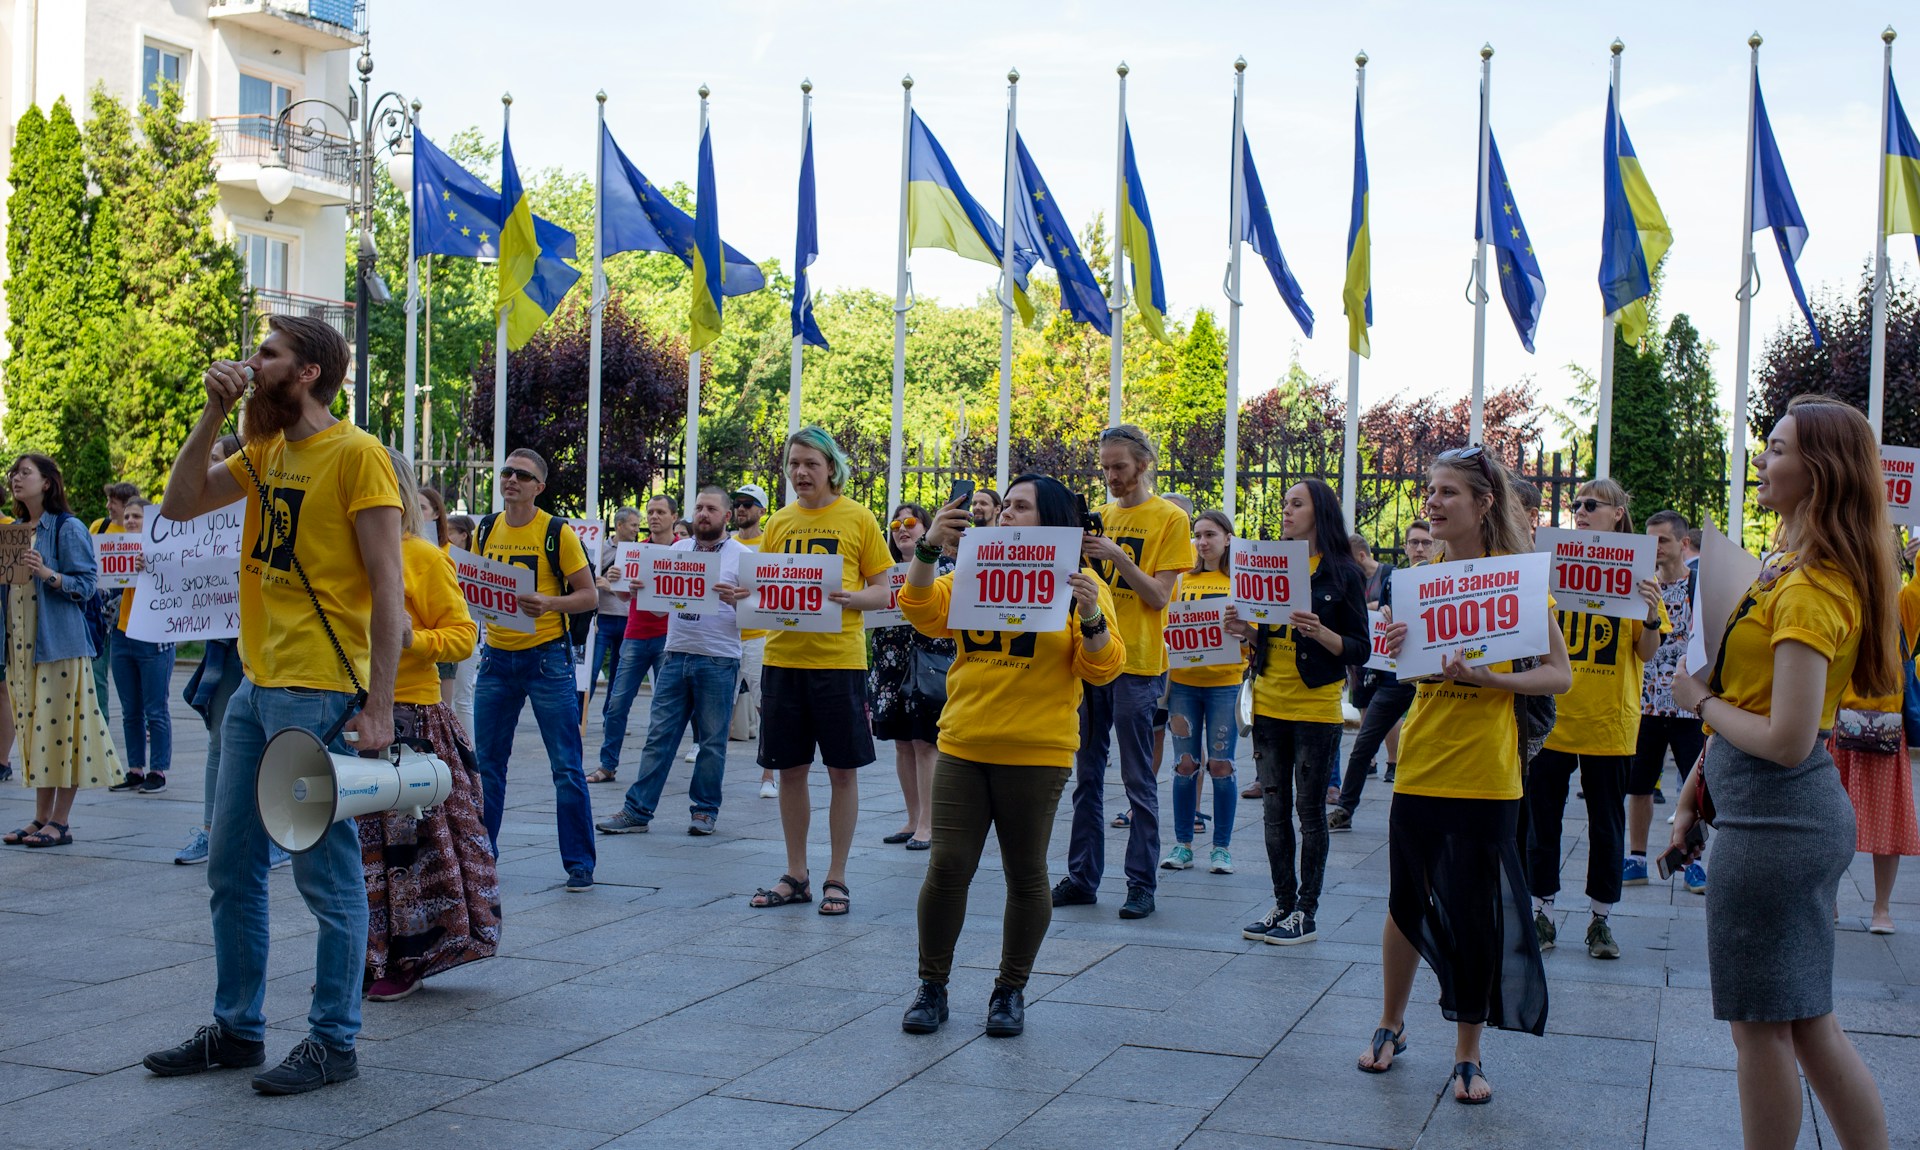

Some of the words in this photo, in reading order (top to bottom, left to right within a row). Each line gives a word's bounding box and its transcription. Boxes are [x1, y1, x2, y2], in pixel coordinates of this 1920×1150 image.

[1880, 459, 1915, 474] акон
[150, 513, 195, 544] Can
[203, 513, 240, 546] you
[1123, 526, 1148, 534] PLANET
[145, 551, 175, 574] your
[181, 538, 203, 567] pet
[212, 534, 229, 556] for
[489, 543, 513, 551] UNIQUE
[514, 544, 540, 552] PLANET
[100, 555, 135, 574] 1001
[152, 572, 174, 595] Чи
[653, 575, 705, 598] 10019
[975, 568, 1055, 604] 10019
[1234, 572, 1290, 603] 10019
[1555, 563, 1632, 595] 10019
[458, 581, 518, 614] 10019
[757, 585, 823, 612] 10019
[1111, 591, 1134, 600] АНЕТА
[164, 615, 211, 633] ЗАРАДИ
[1168, 611, 1180, 624] ій
[1420, 594, 1519, 643] 10019
[1164, 625, 1222, 651] 10019
[990, 658, 1031, 670] ПЛАНЕТА
[1466, 651, 1484, 659] OFF
[1580, 667, 1615, 676] ПЛАНЕТА
[1436, 690, 1478, 700] ПЛАНЕТА
